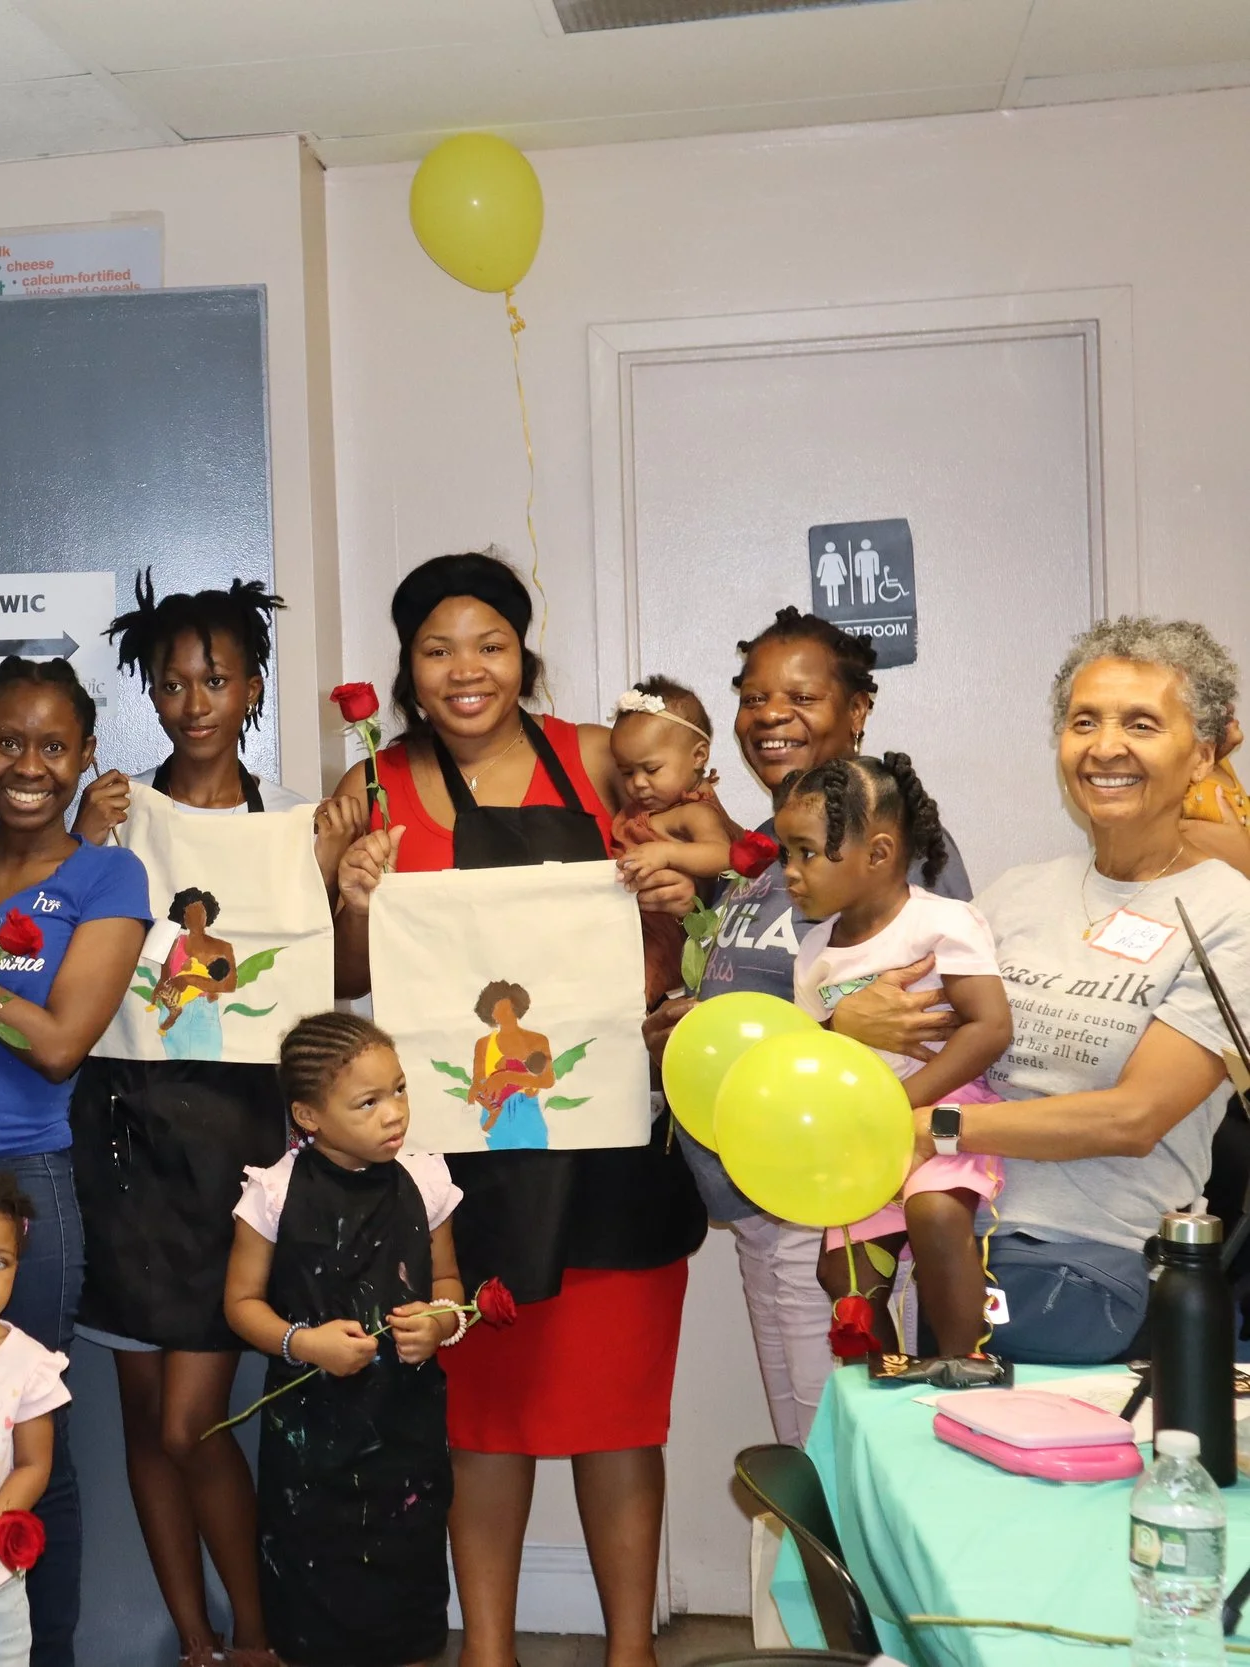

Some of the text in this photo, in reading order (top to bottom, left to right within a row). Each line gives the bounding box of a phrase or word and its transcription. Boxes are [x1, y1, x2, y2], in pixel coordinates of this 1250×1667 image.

[6, 259, 54, 273] cheese
[22, 269, 132, 288] calcium-fortified
[703, 947, 734, 982] his
[1065, 973, 1155, 1007] milk
[1018, 1017, 1109, 1048] is the perfect
[1038, 1003, 1063, 1018] that
[1067, 1008, 1080, 1021] is
[1084, 1014, 1138, 1034] custom
[1007, 1054, 1049, 1070] needs.
[1027, 1036, 1049, 1053] has
[1052, 1044, 1071, 1059] all
[1075, 1049, 1099, 1066] the
